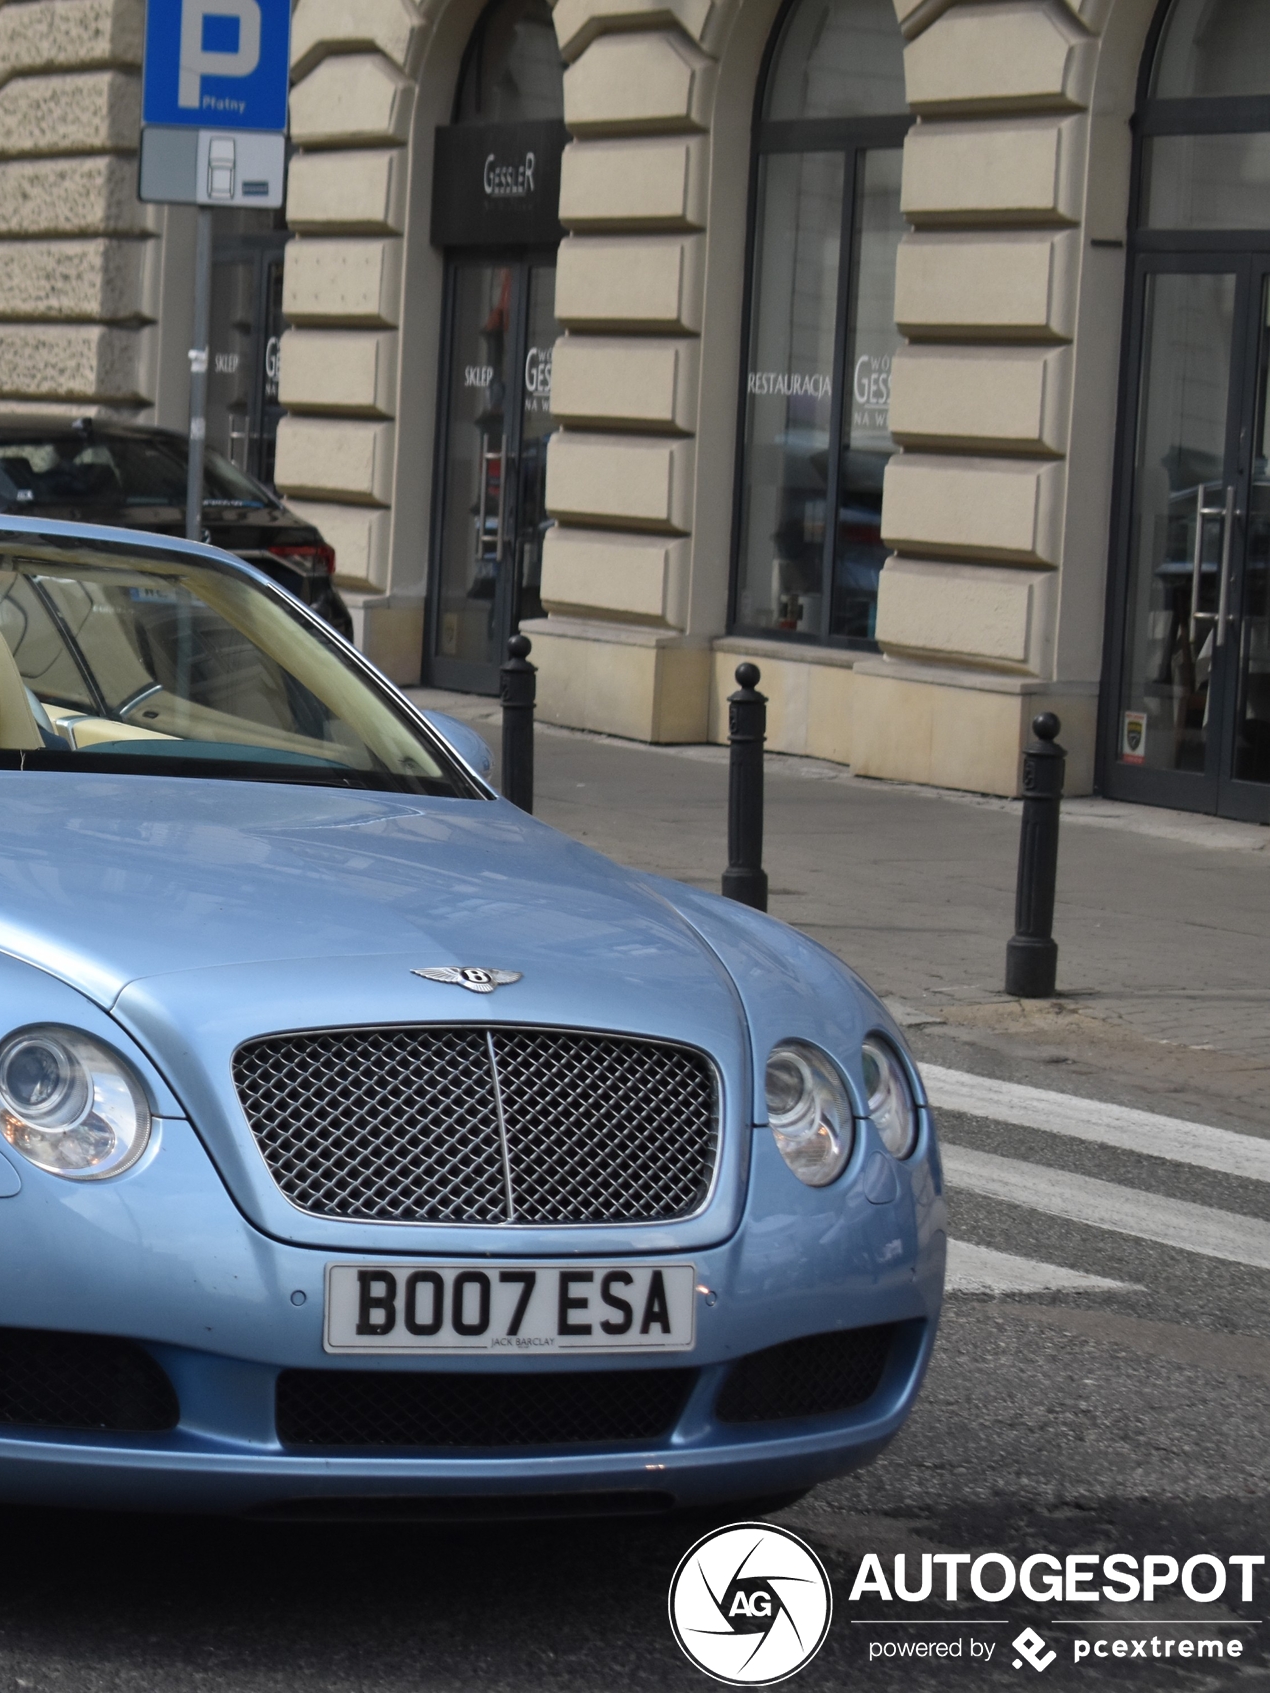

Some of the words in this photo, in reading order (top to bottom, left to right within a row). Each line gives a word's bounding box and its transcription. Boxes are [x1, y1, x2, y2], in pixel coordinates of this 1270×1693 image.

[178, 0, 262, 109] P
[465, 365, 494, 386] SKLEP
[748, 372, 831, 400] RESTAURACJA
[557, 1270, 671, 1335] ESA
[491, 1338, 513, 1348] JACK
[515, 1338, 555, 1346] BARCLAY
